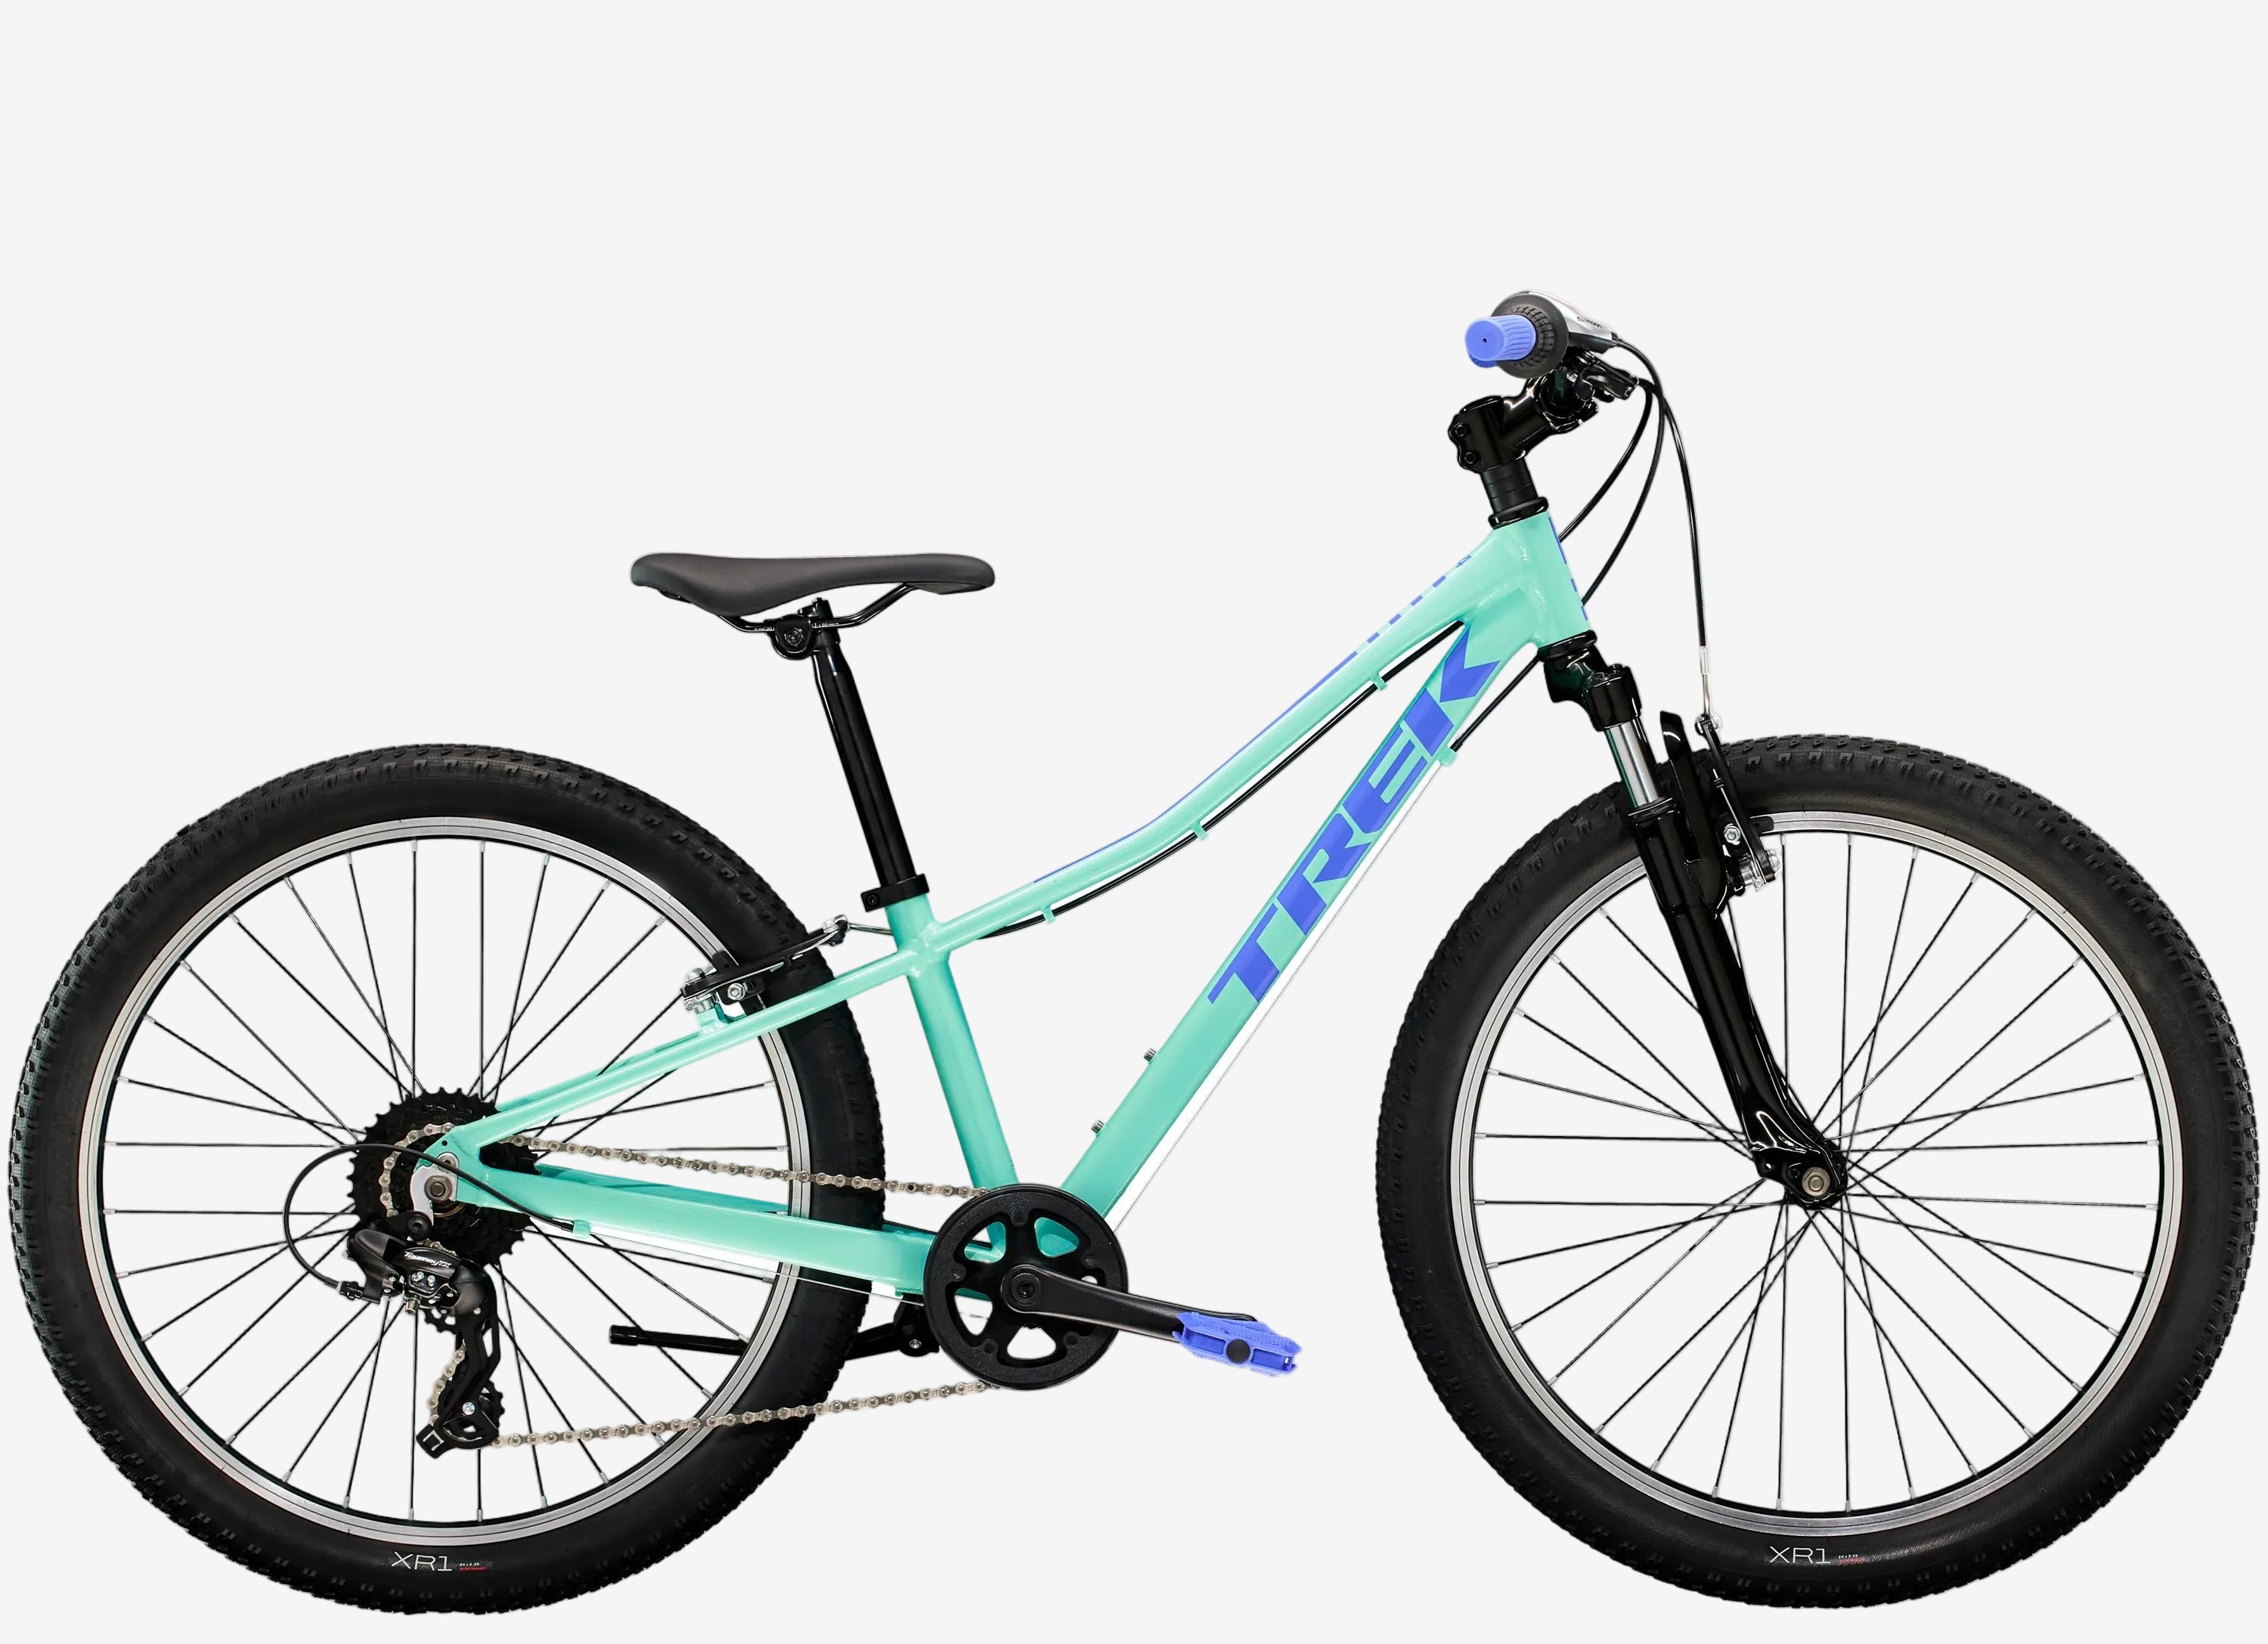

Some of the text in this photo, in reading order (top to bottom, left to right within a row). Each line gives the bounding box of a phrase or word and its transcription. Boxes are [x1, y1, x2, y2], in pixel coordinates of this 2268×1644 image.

[1207, 625, 1501, 1004] TREK
[392, 1551, 453, 1571] XR1
[1769, 1546, 1831, 1564] XR1
